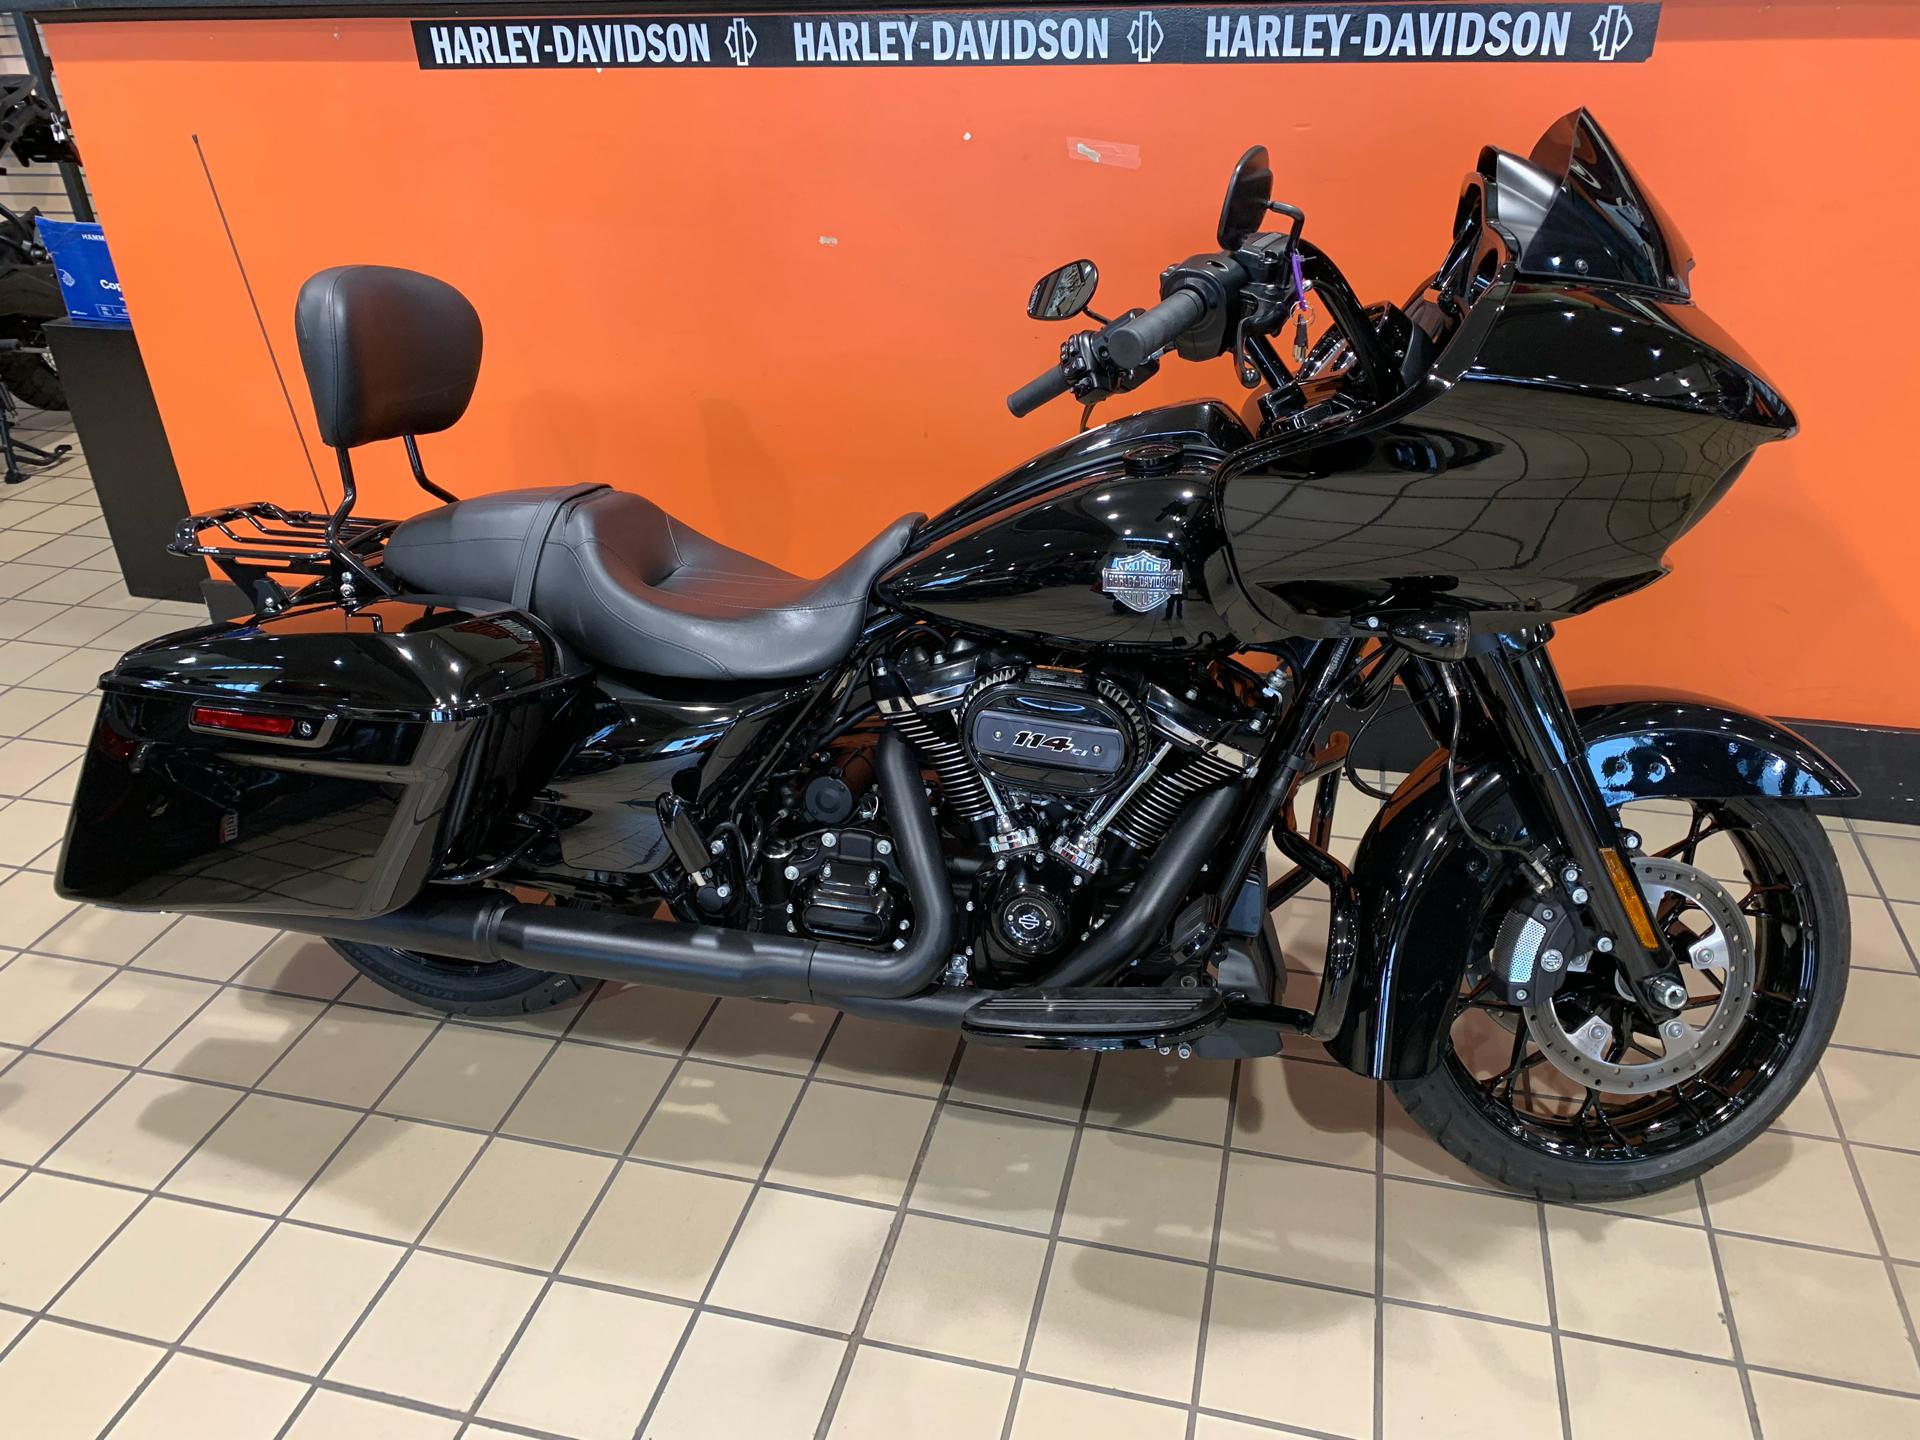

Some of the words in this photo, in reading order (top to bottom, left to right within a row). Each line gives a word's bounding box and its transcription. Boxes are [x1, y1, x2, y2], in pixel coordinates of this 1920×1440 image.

[430, 23, 711, 64] HARLEY-DAVIDSON
[793, 17, 1109, 61] HARLEY-DAVIDSON
[1205, 11, 1572, 58] HARLEY-DAVIDSON
[1124, 558, 1161, 572] MOTOR
[1108, 574, 1177, 589] HARLEY-DAVIDSON
[1013, 730, 1074, 752] 114
